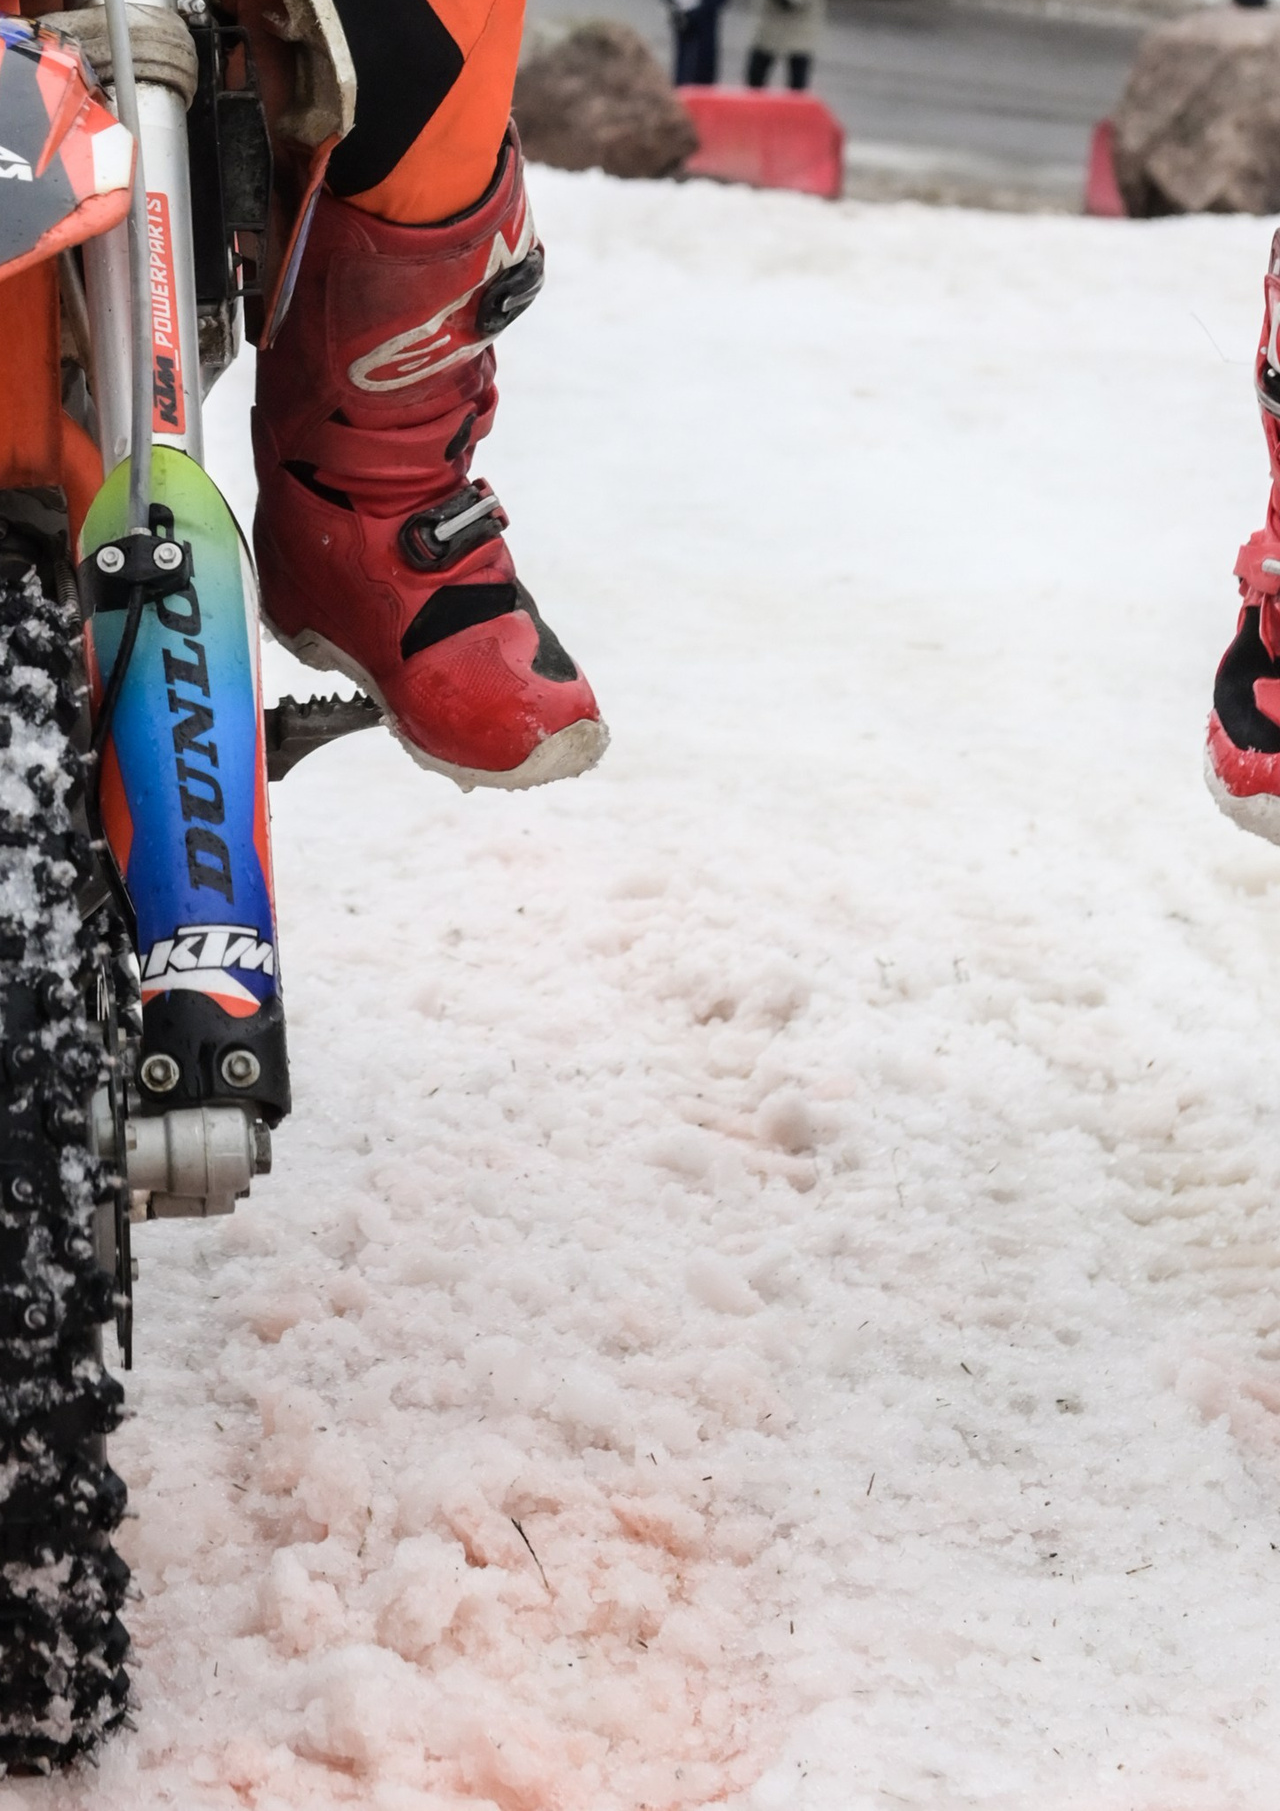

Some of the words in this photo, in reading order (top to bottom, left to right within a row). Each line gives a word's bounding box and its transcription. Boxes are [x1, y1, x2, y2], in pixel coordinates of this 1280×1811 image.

[146, 198, 173, 349] POWERPARTS
[153, 355, 178, 427] KTM
[140, 925, 275, 980] KTM
